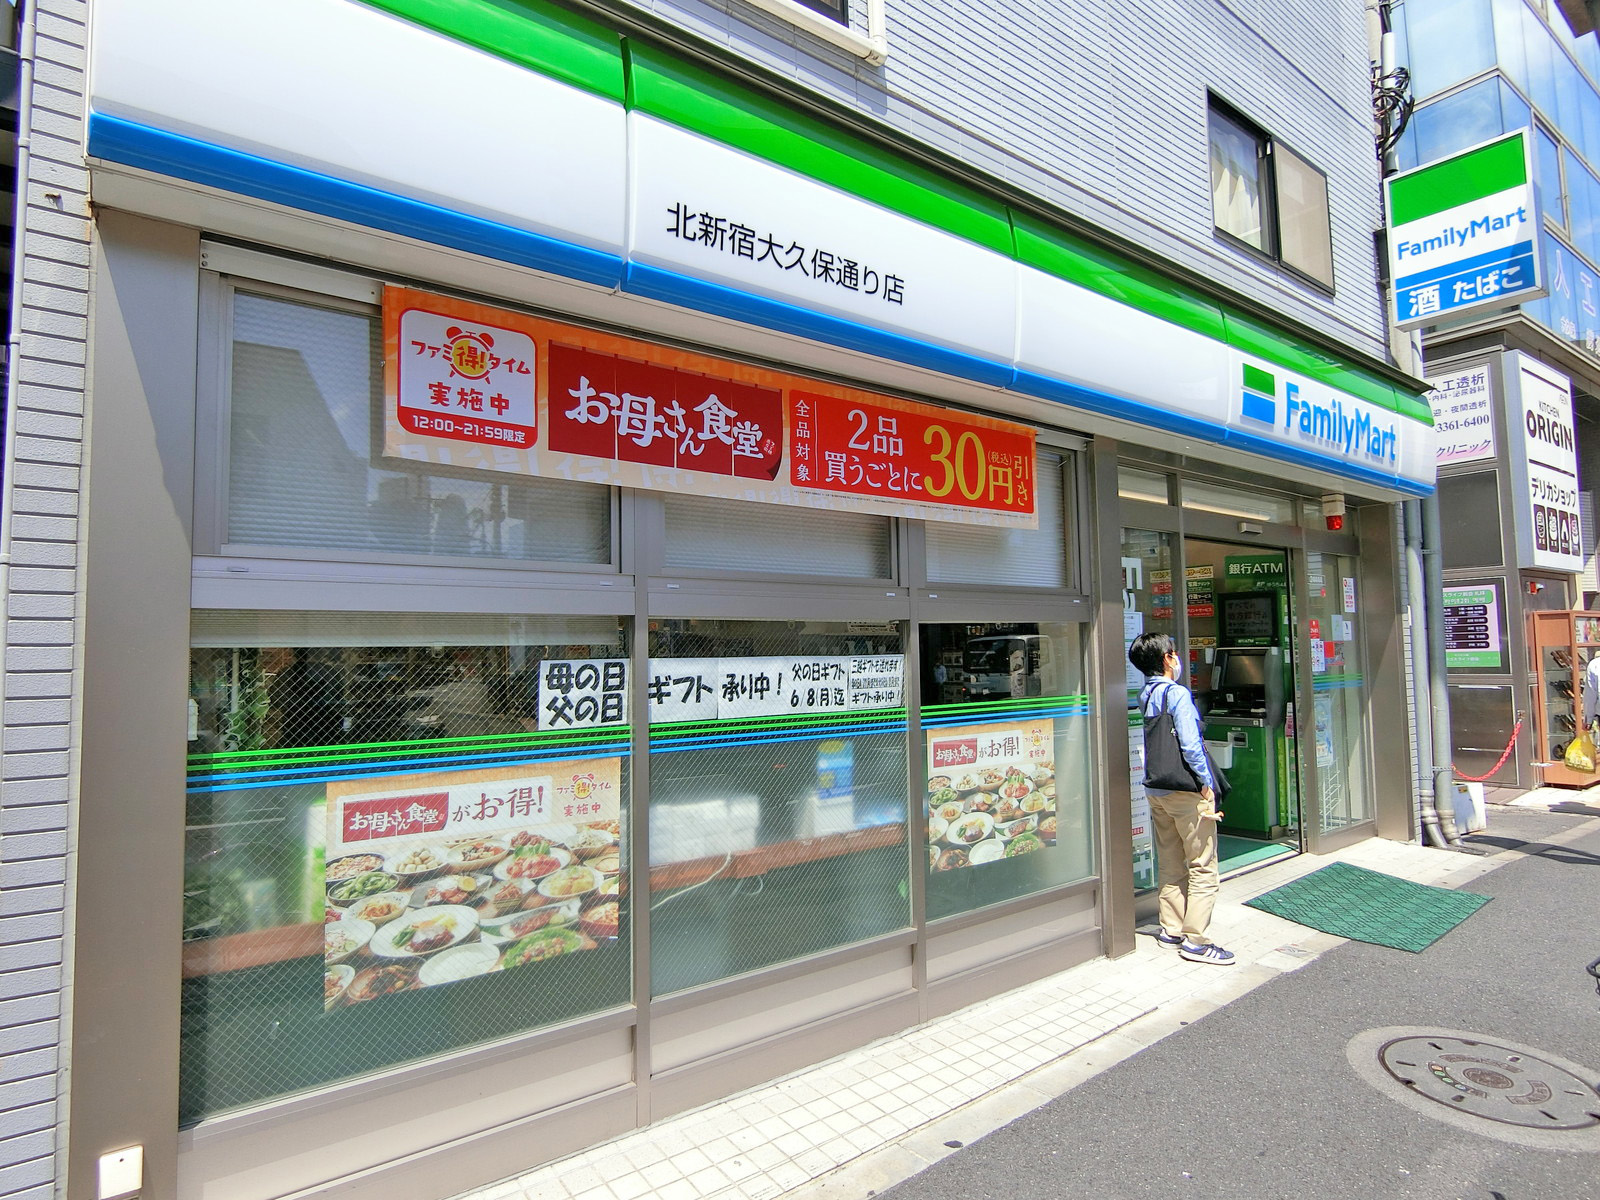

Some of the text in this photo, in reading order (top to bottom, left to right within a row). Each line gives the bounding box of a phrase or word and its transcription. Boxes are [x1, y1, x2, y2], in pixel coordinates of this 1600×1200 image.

[1397, 206, 1527, 260] FamilyMart
[666, 202, 905, 306] 北新宿大久保通り店
[1408, 265, 1523, 317] 酒 たばこ
[428, 382, 509, 416] 実施中
[1538, 400, 1560, 419] KITCHEN
[565, 376, 764, 459] お母さん食堂
[847, 409, 903, 456] 2品
[1286, 381, 1396, 461] FamilyMart
[1526, 409, 1573, 453] ORIGIN
[795, 400, 811, 482] 全品対象
[1436, 439, 1491, 458] クリニック
[825, 450, 923, 492] 買うごとに
[1531, 477, 1576, 508] デリカショップ
[1228, 563, 1283, 575] 銀行ATM
[546, 661, 626, 695] 母の日
[648, 674, 713, 704] ギフト
[792, 662, 845, 682] 父の日ギフト
[546, 692, 624, 728] 父の日
[350, 802, 439, 833] お母さん食堂
[563, 802, 602, 817] 実施中
